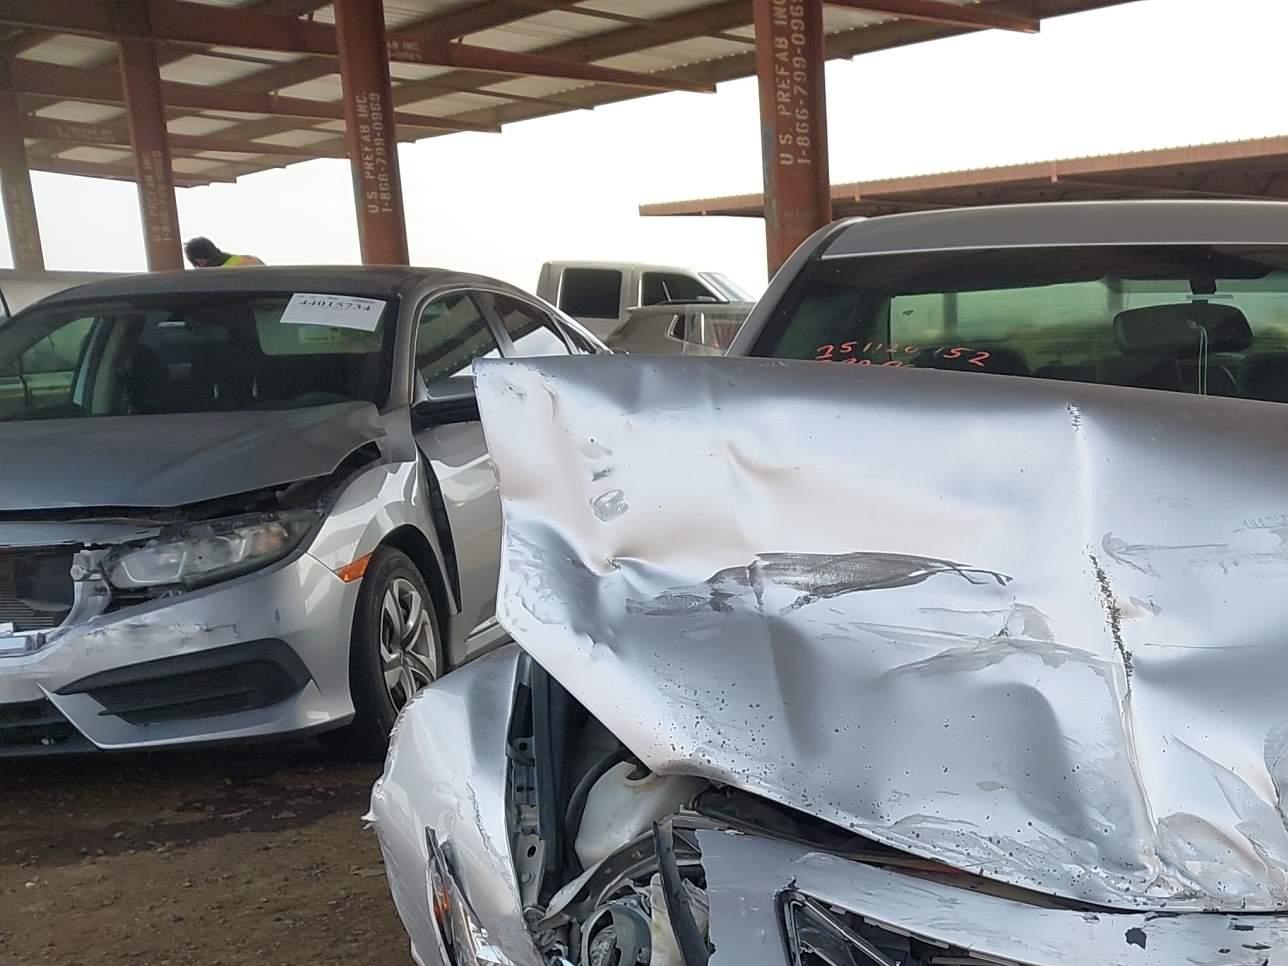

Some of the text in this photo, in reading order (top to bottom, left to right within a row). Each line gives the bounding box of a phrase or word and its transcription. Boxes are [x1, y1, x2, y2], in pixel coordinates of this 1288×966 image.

[774, 36, 793, 116] PREFAB
[789, 0, 812, 165] 1-866-799-096
[359, 124, 377, 179] PREFAB
